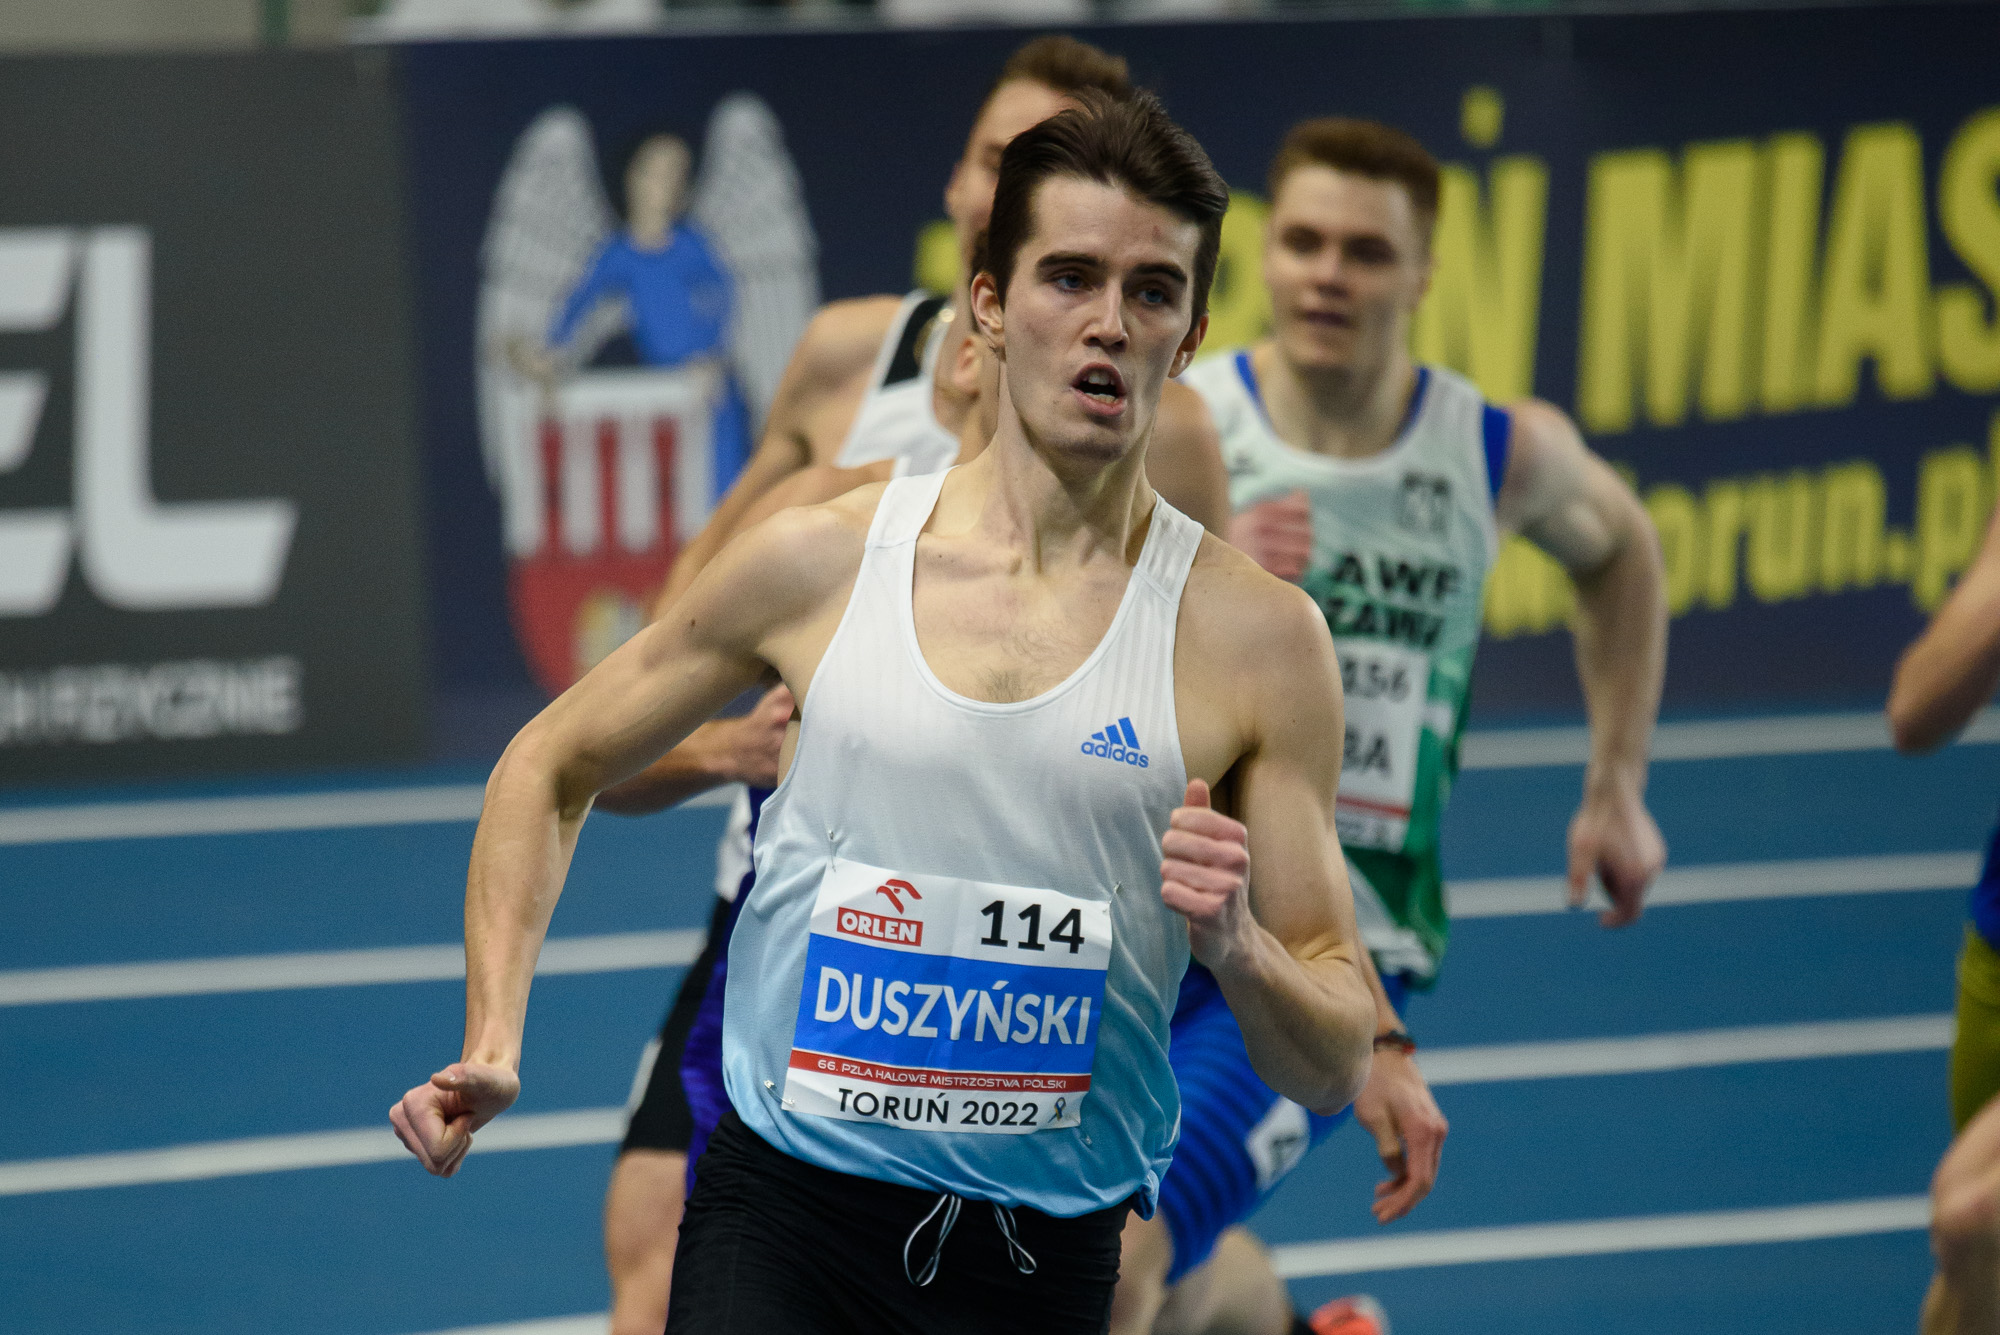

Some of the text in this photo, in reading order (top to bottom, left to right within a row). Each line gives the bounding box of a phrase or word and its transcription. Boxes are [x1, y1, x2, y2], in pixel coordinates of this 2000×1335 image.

[1330, 551, 1460, 601] AWF
[1080, 741, 1150, 769] adidas
[840, 911, 919, 944] ORLEN
[980, 899, 1085, 954] 114
[814, 965, 1093, 1046] DUSZYŃSKI
[817, 1058, 1067, 1089] 66. PZLA HALOWE MISTRZOSTWA POLSKI
[838, 1087, 1039, 1127] TORUŃ 2022
